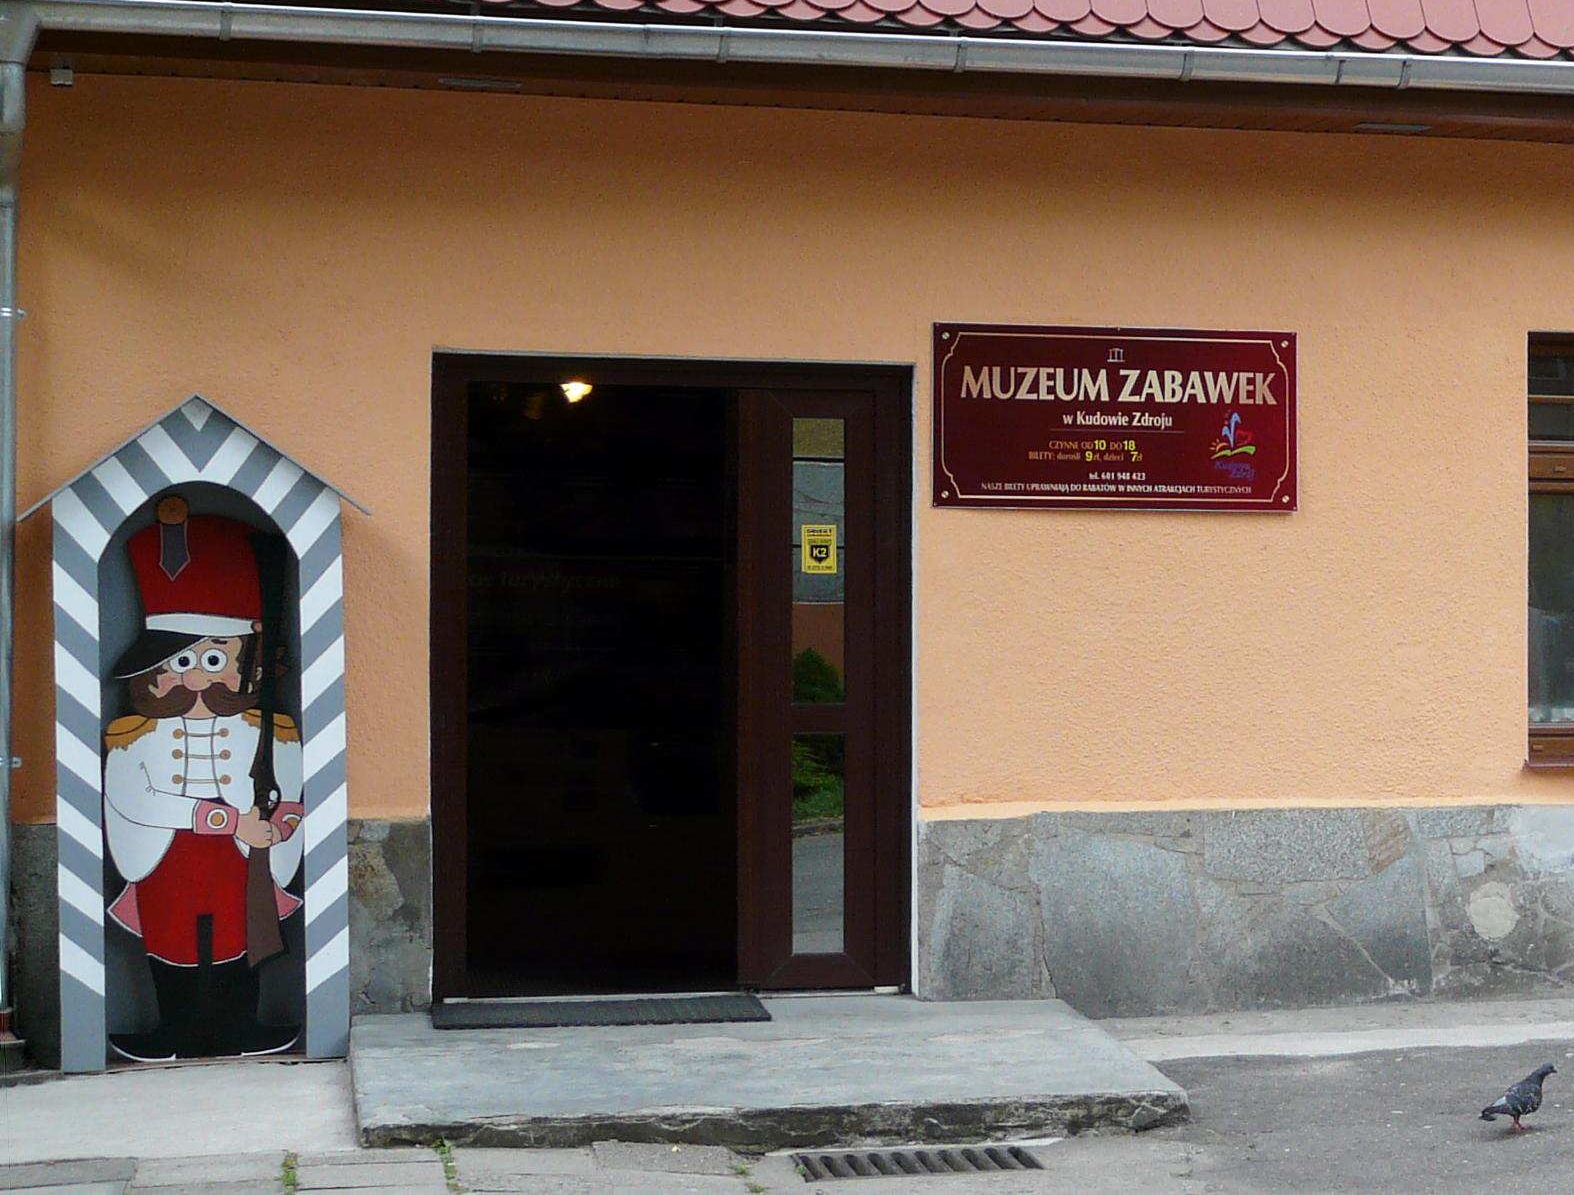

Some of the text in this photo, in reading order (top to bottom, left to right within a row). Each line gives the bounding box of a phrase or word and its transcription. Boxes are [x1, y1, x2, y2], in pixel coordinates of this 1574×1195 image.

[960, 365, 1278, 405] MUZEUM ZABAWEK
[1062, 411, 1173, 430] w Kudowie Zdroju
[1094, 439, 1106, 450] 10
[1110, 440, 1122, 450] DO
[1123, 440, 1136, 450] 18
[1085, 451, 1093, 462] 9
[1130, 451, 1138, 462] 7
[1070, 484, 1082, 492] DO
[812, 547, 827, 558] K2
